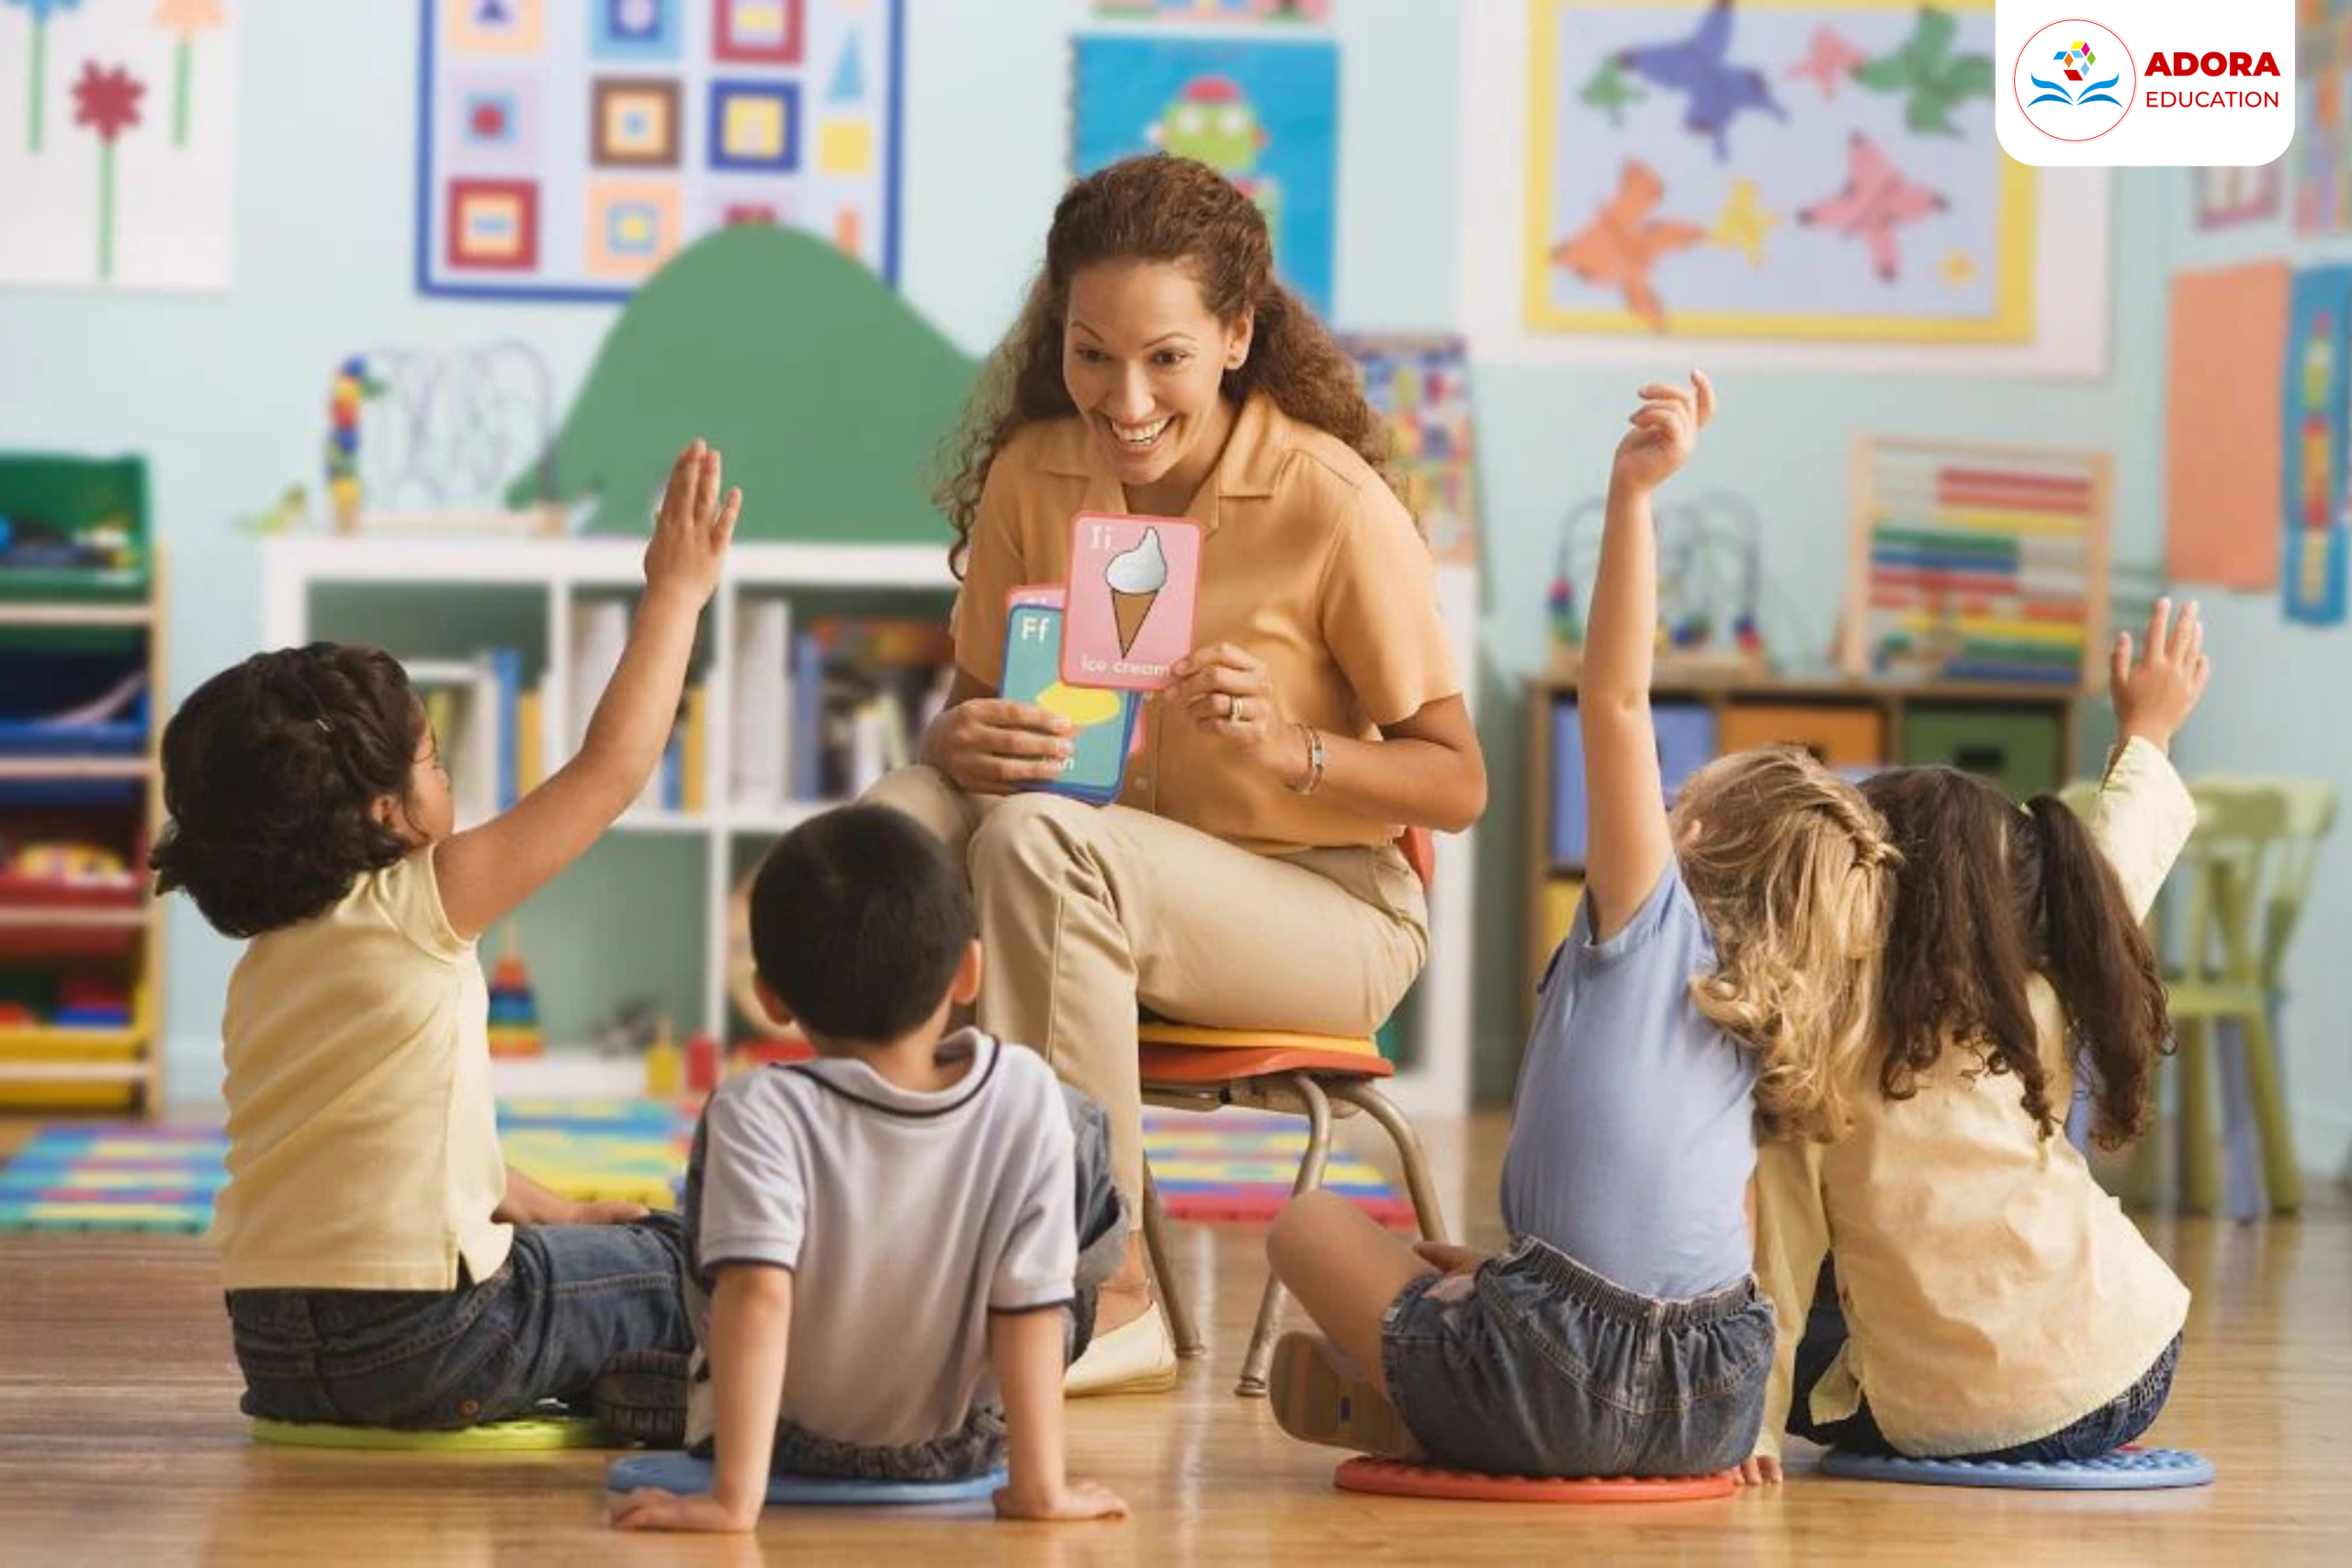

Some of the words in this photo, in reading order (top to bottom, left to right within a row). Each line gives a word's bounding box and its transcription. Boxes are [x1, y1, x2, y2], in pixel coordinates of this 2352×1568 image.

[1090, 525, 1111, 549] Ii
[1022, 616, 1050, 642] Ff
[1082, 654, 1106, 671] ice
[1113, 660, 1170, 677] cream
